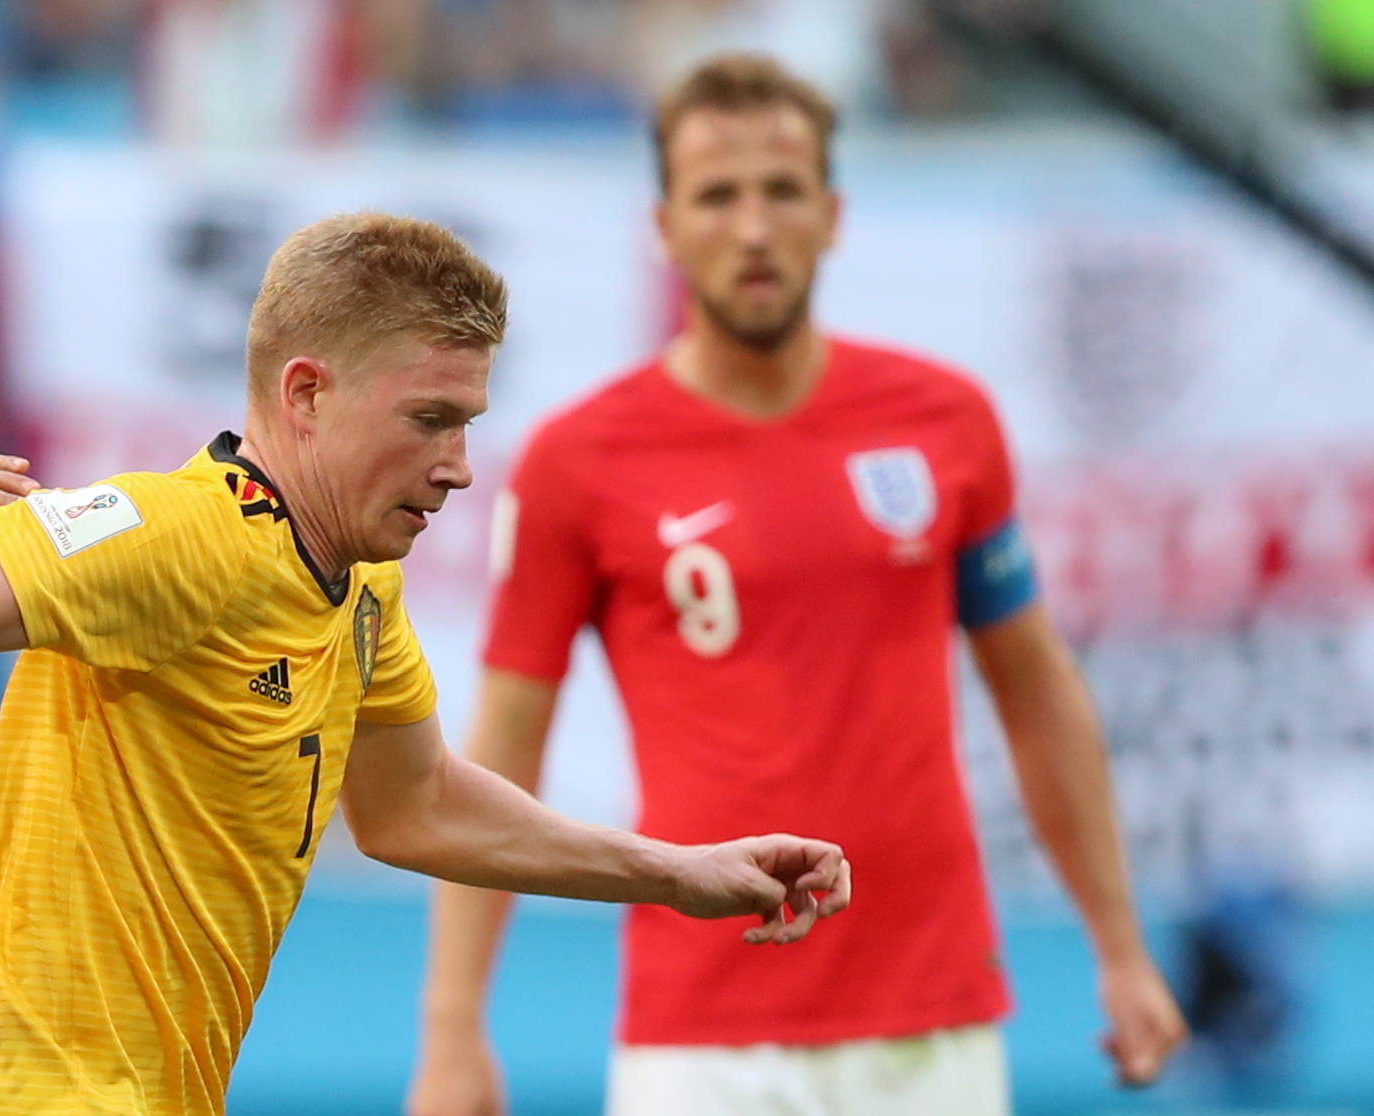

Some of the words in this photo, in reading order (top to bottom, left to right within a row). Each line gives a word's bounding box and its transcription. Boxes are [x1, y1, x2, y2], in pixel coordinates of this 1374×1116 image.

[54, 524, 73, 551] 2018
[663, 541, 742, 659] 9
[248, 678, 293, 706] adidas
[294, 732, 322, 859] 7
